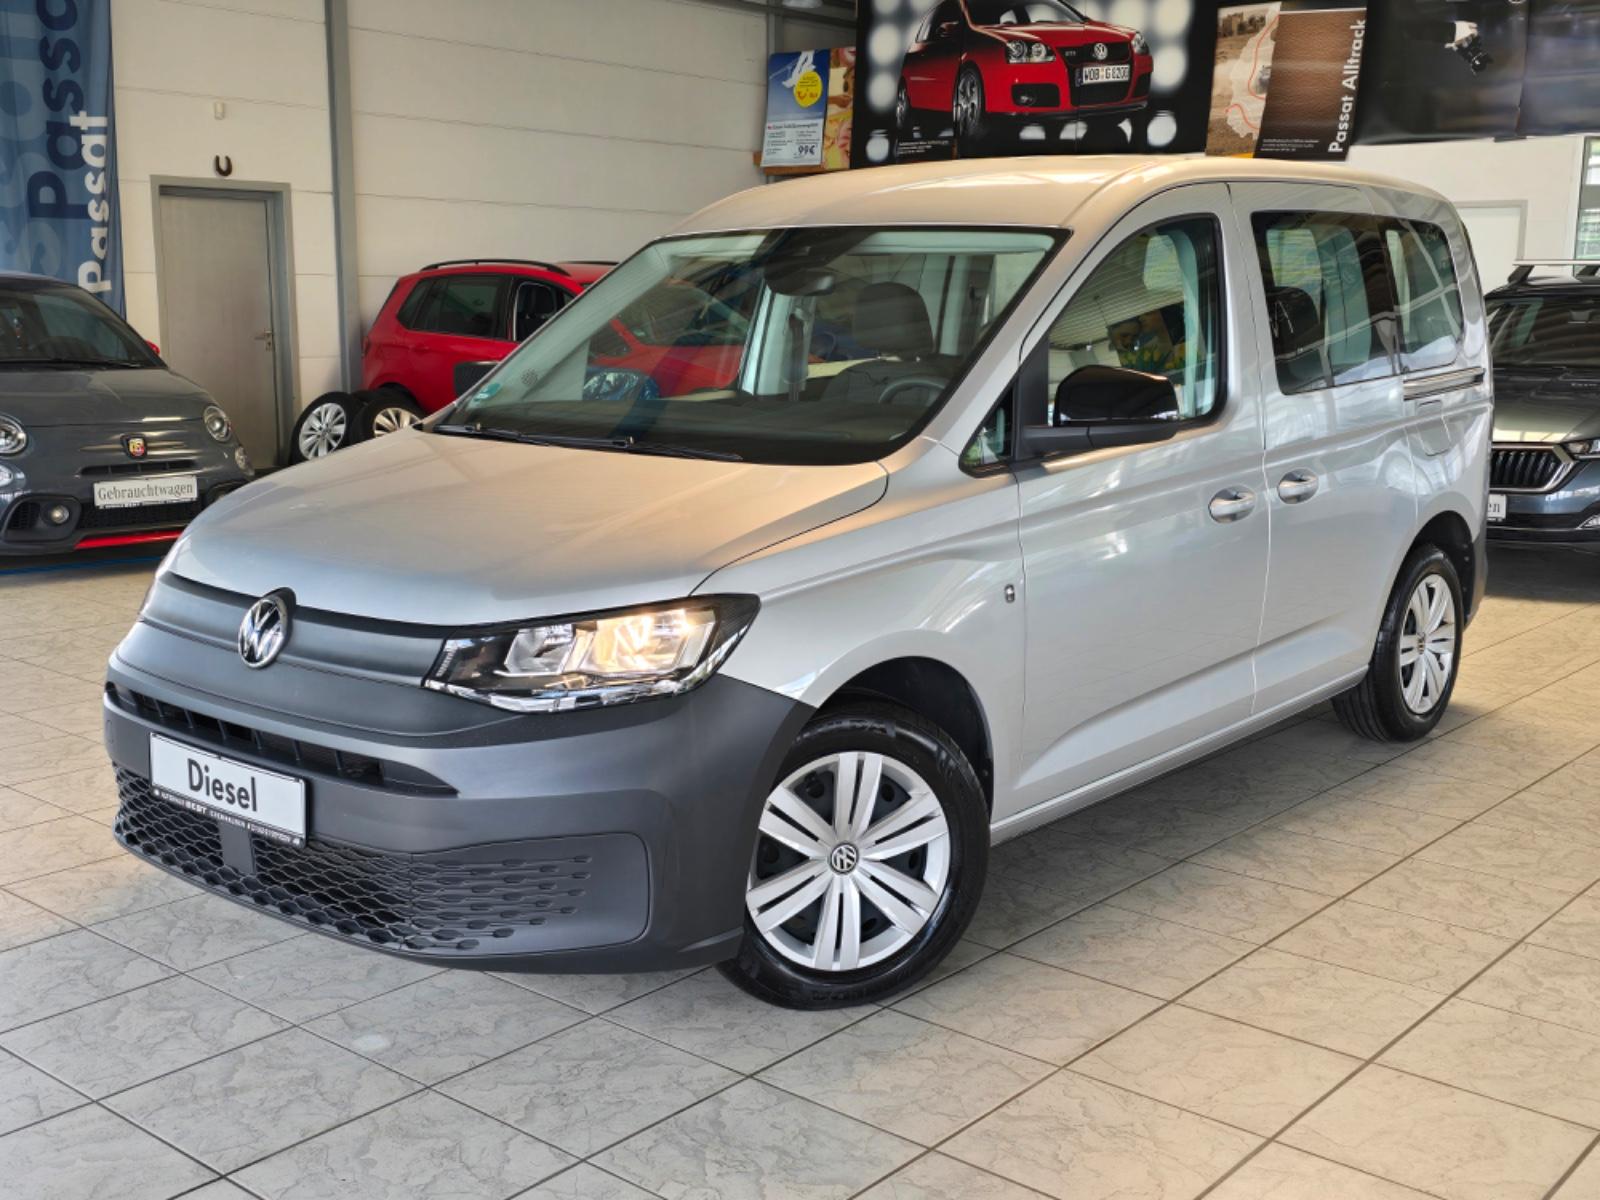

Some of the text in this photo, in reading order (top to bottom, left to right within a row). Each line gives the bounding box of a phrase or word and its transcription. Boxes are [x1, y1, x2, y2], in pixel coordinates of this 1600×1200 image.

[1328, 19, 1367, 152] Passat Alltrack
[69, 110, 112, 294] Passat
[98, 483, 193, 501] Gebrauchtwagen
[187, 758, 258, 812] Diesel
